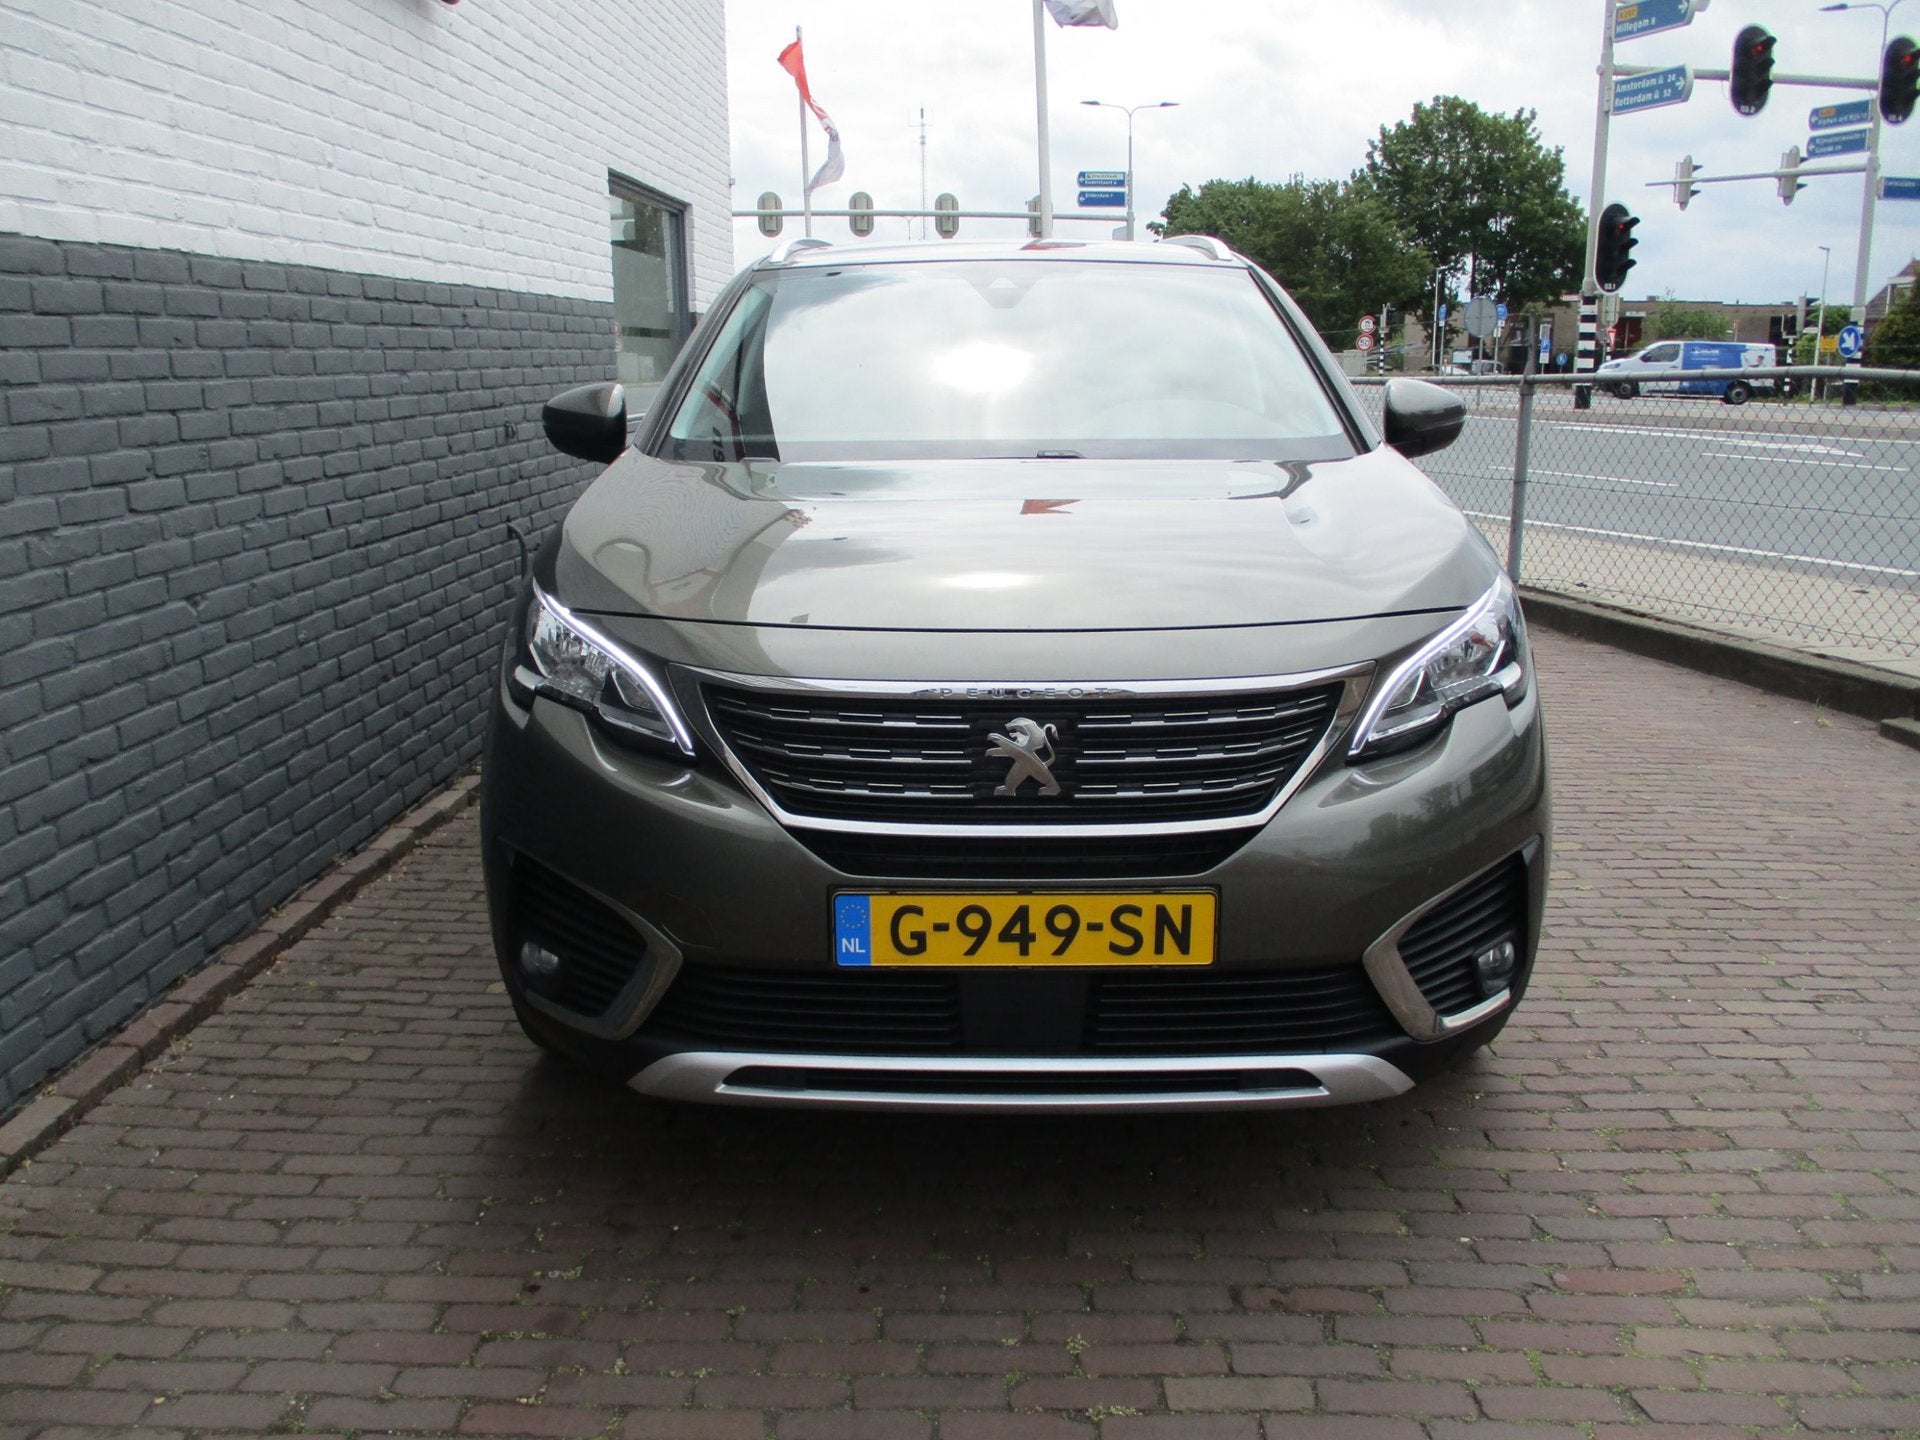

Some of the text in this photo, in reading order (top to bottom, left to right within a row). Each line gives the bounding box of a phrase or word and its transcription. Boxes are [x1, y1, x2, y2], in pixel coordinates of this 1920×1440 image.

[1616, 19, 1649, 34] Hillegom
[1615, 77, 1657, 94] Amsterdam
[1614, 92, 1652, 107] Rotterdam
[939, 687, 1109, 699] PEUGEOT
[889, 903, 1192, 956] G-949-SN
[841, 938, 866, 953] NL
